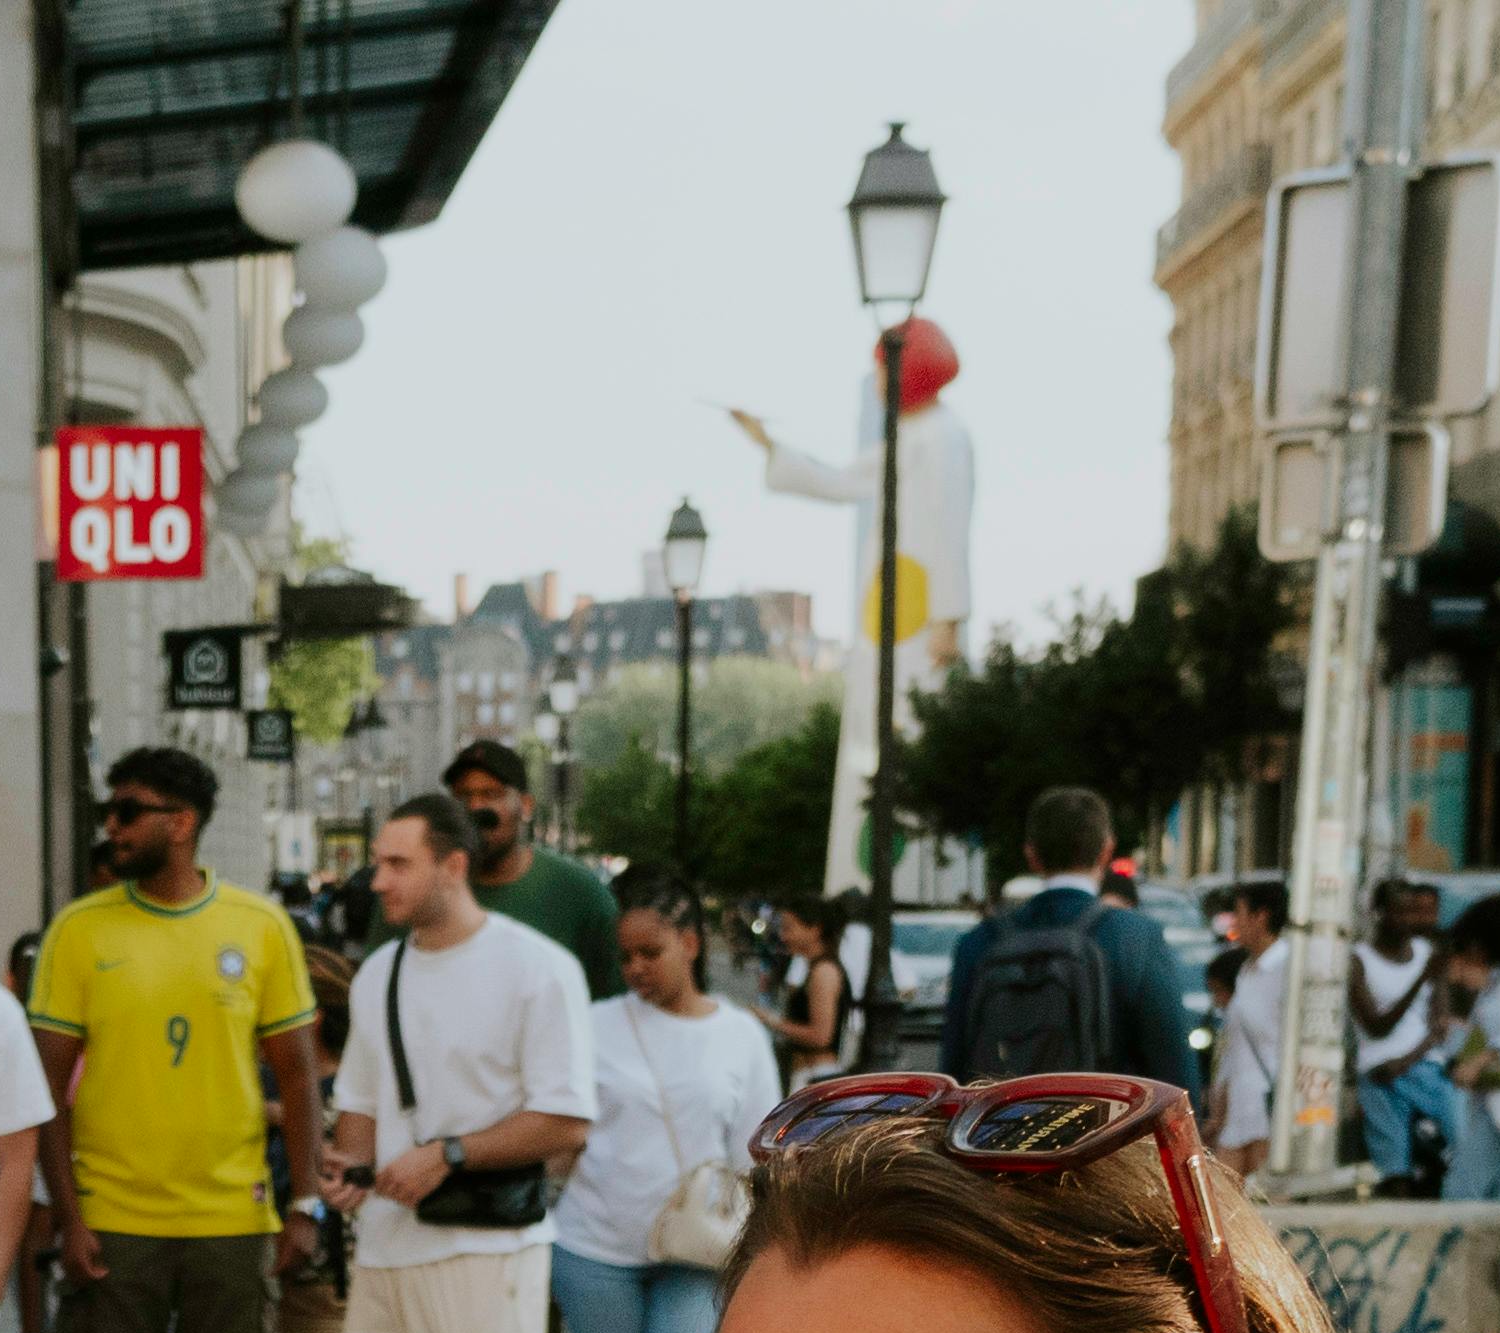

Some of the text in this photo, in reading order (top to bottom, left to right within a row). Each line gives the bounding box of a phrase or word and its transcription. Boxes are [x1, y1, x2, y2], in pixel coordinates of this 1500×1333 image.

[69, 441, 180, 501] UNI
[69, 505, 192, 574] QLO
[165, 1015, 190, 1067] 9
